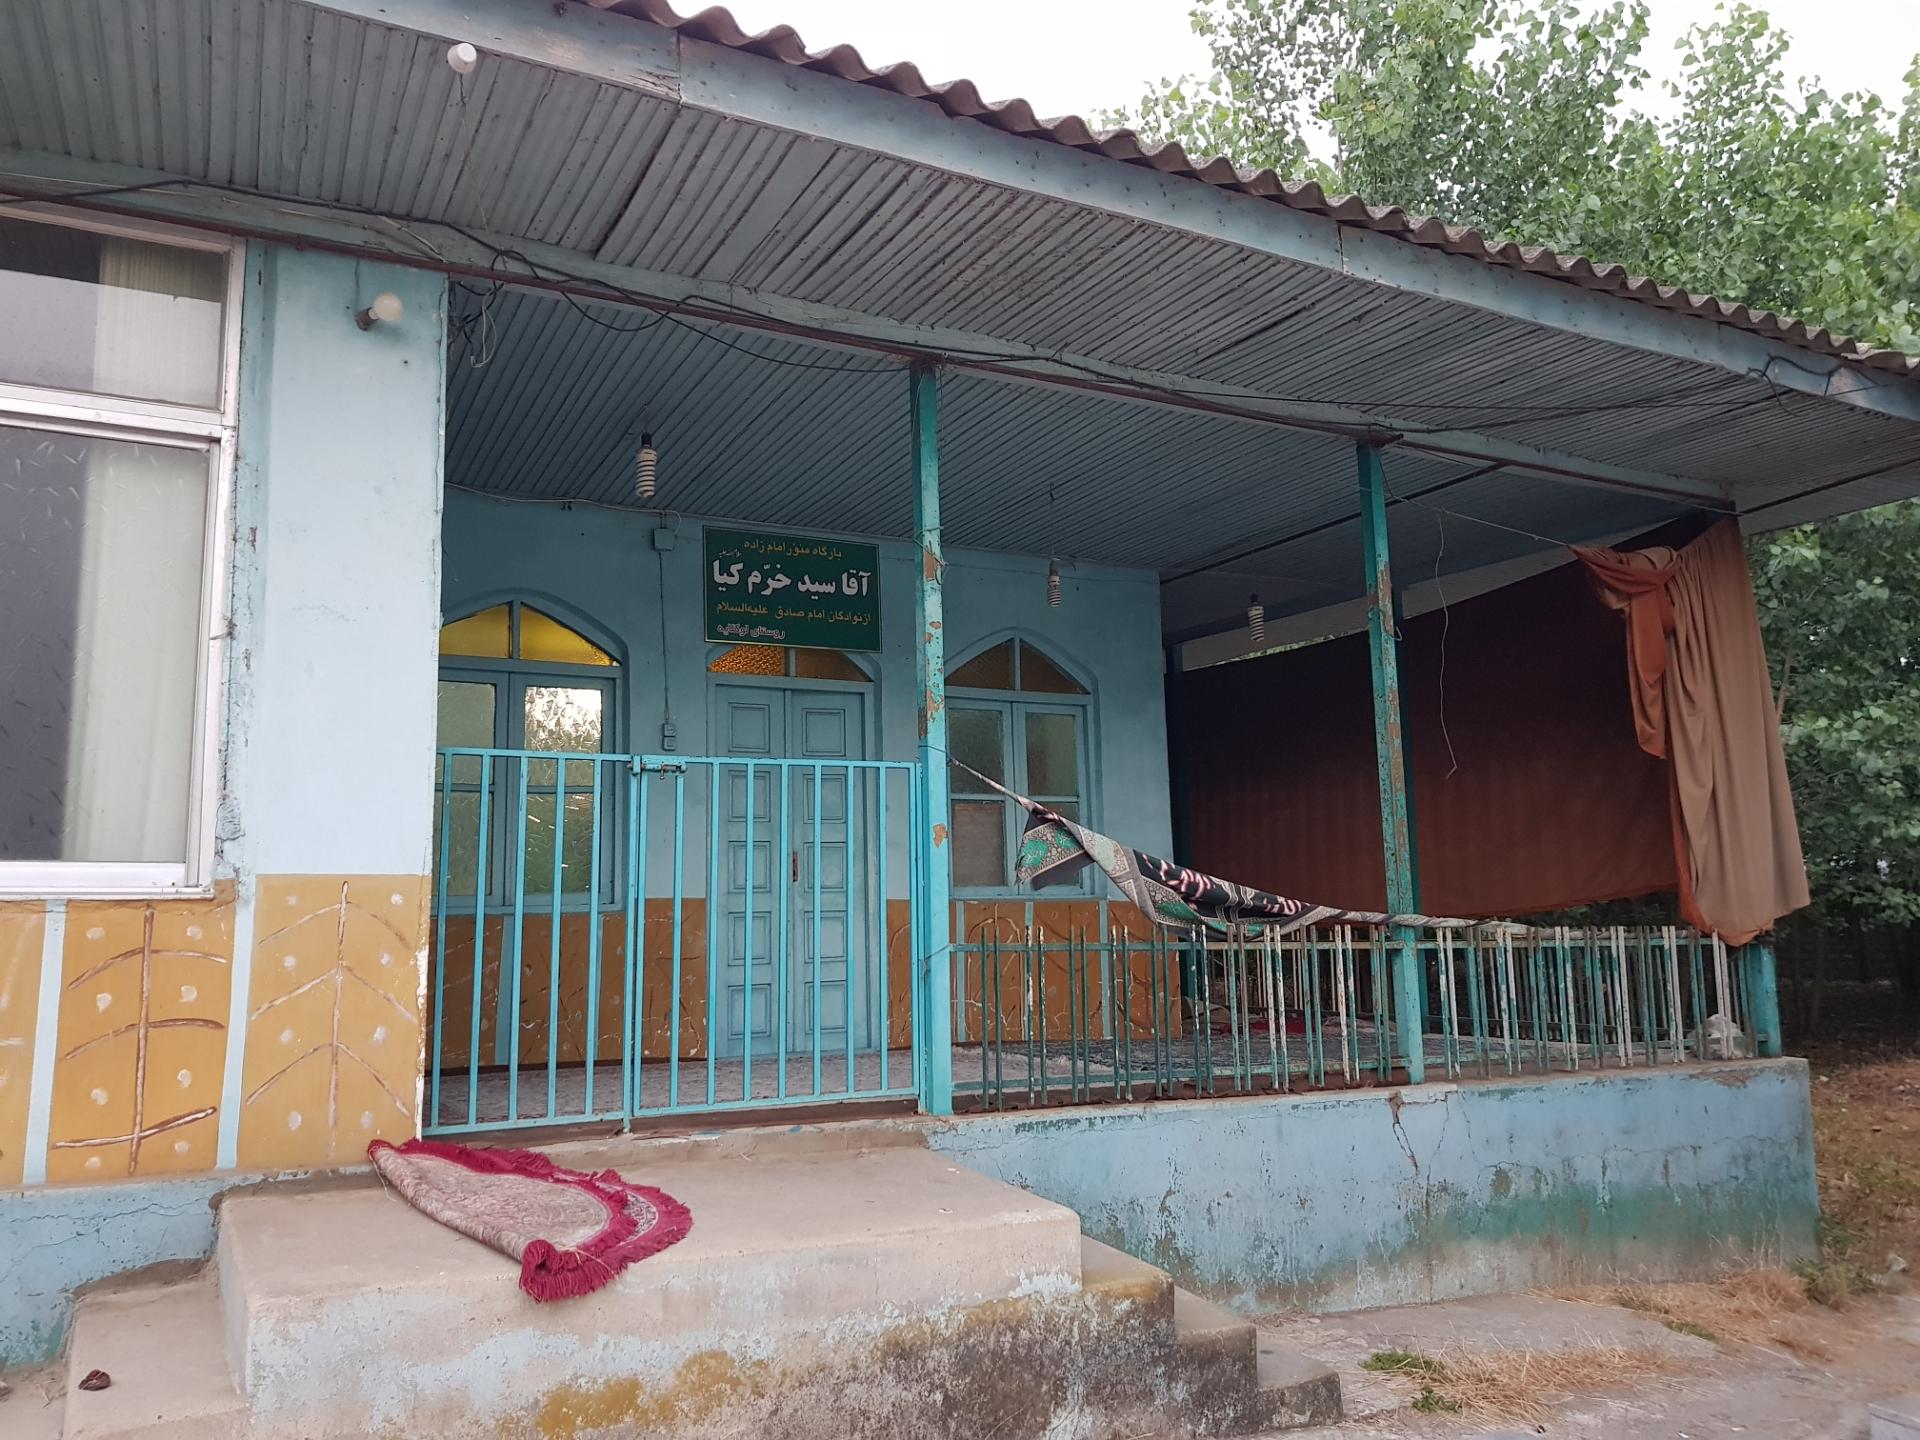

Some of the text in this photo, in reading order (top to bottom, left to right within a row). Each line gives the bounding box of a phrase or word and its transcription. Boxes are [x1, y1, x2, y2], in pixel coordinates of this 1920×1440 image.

[743, 539, 765, 554] زاده
[767, 541, 785, 555] امام
[713, 559, 744, 592] کیا
[841, 568, 871, 596] آقا
[797, 573, 836, 600] سید
[774, 605, 805, 620] صادق
[808, 608, 825, 620] امام
[750, 625, 785, 640] روستای
